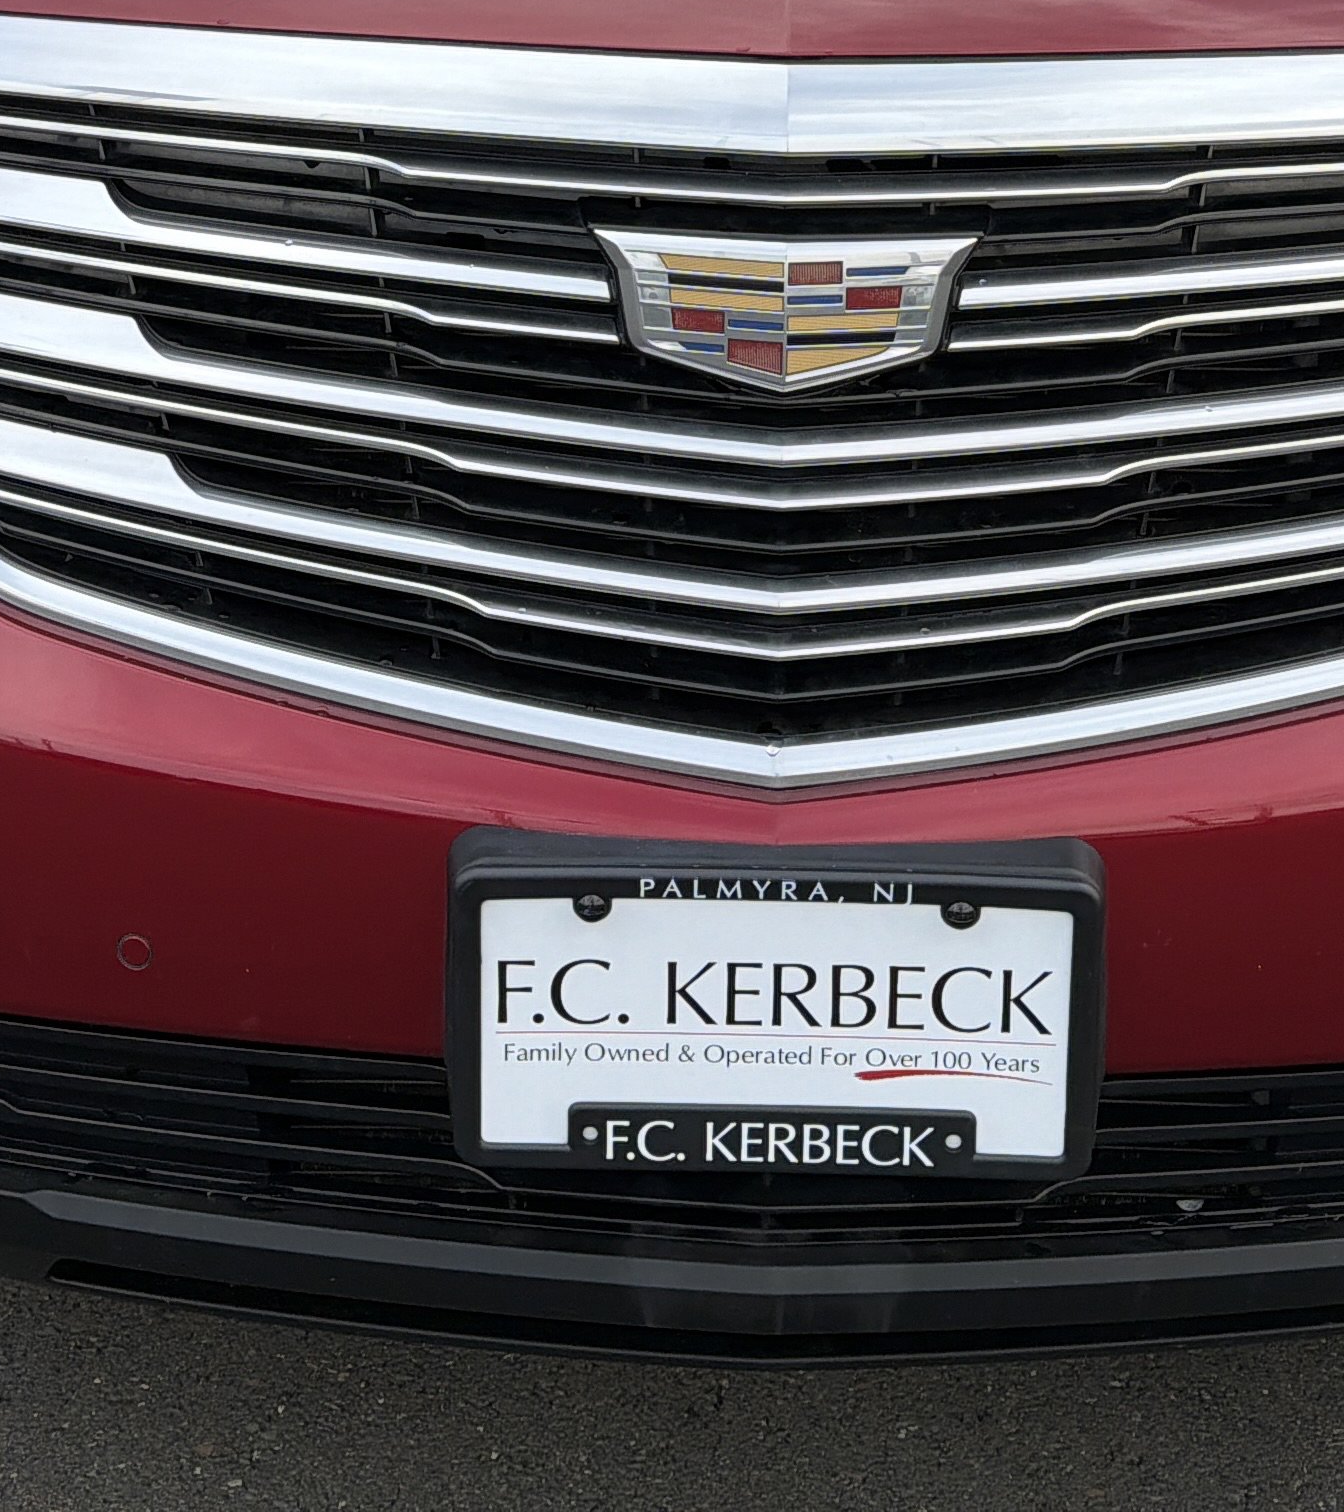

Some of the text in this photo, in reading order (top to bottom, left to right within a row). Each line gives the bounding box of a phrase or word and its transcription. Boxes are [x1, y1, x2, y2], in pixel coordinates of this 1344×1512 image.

[639, 877, 915, 906] PALMYRA, NJ
[495, 958, 1055, 1037] F.C. KERBECK
[503, 1041, 1041, 1075] Family Owned & Operated For Over 100 Years
[604, 1120, 936, 1169] F.C. KERBECK
